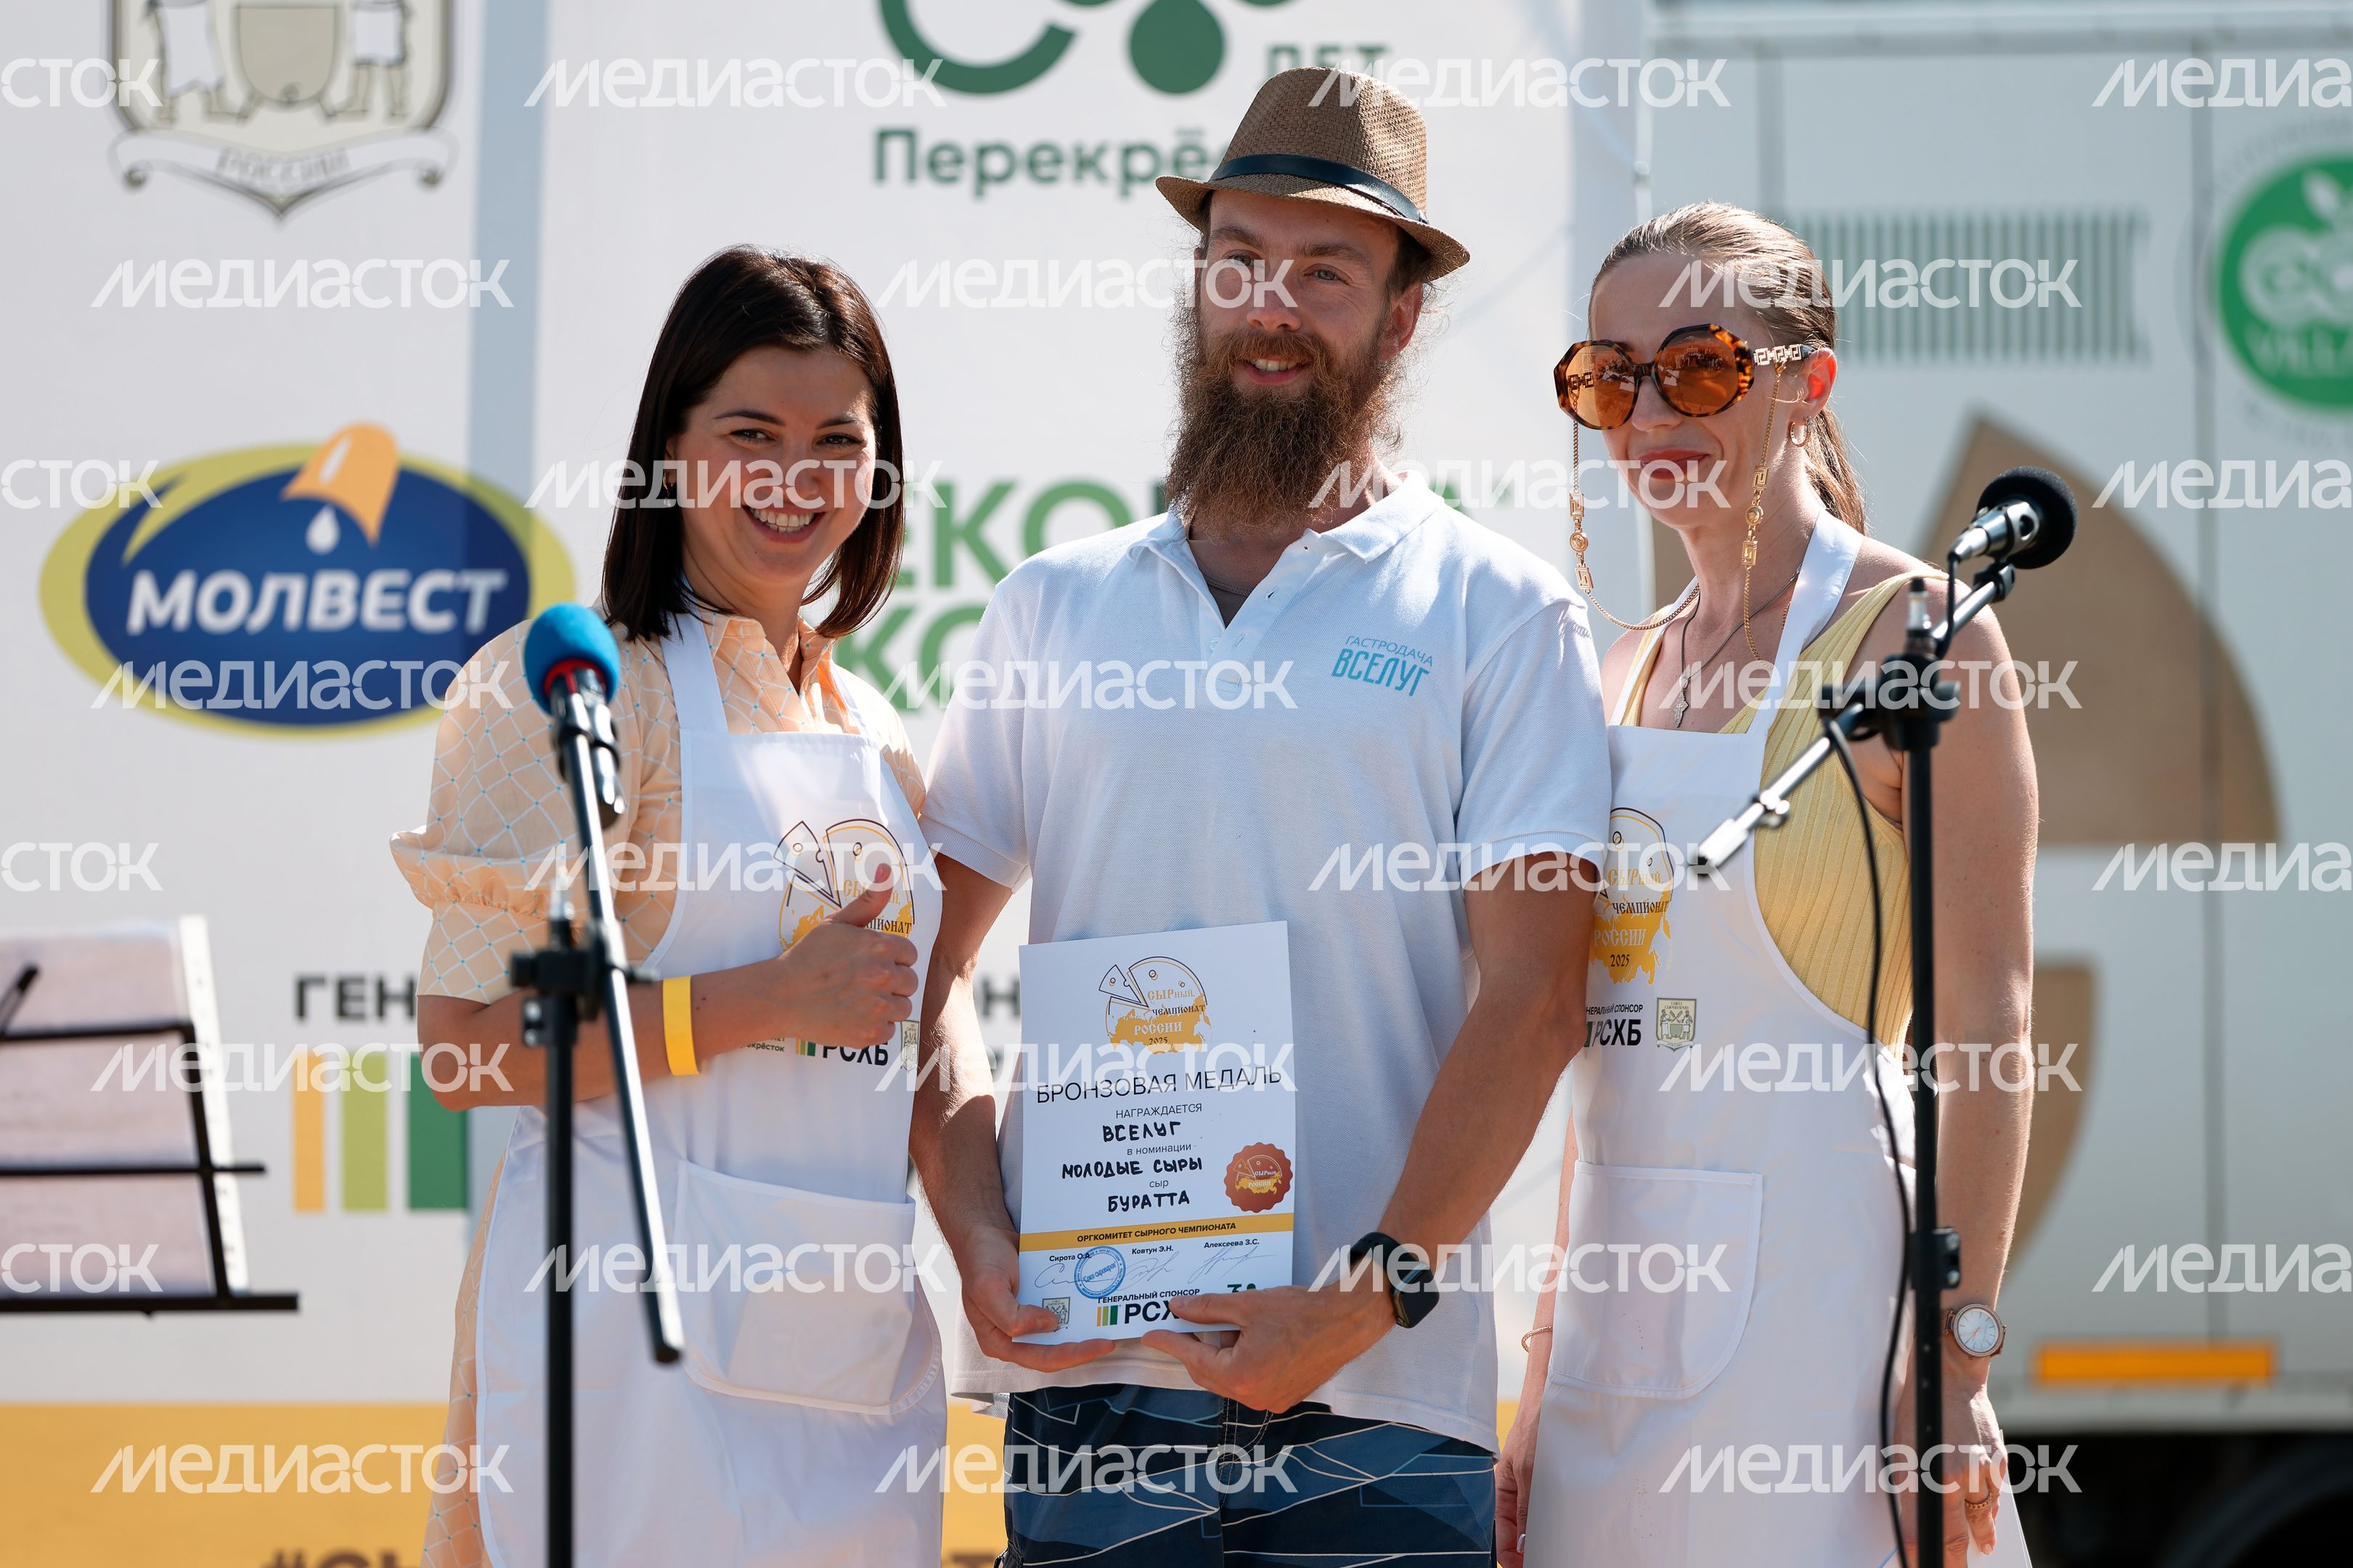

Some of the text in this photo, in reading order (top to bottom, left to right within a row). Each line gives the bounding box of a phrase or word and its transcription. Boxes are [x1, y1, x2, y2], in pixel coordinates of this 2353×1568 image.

[873, 128, 1221, 198] Перекрё
[127, 568, 507, 636] МОЛВЕСТ
[1345, 636, 1434, 667] ГАСТРОДАЧА
[1332, 648, 1430, 697] ВСЕЛУГ
[865, 918, 912, 934] ПИОНАТ
[1593, 928, 1647, 947] РОССИИ
[1610, 954, 1630, 968] 2025
[295, 975, 416, 1024] ГЕН
[1614, 1004, 1643, 1013] СПОНСОР
[1134, 1021, 1183, 1035] РОССИИ
[1591, 1018, 1642, 1047] РСХБ
[1149, 1037, 1168, 1045] 2025
[1037, 1065, 1281, 1103] БРОНЗОВАЯ МЕДАЛЬ
[1116, 1103, 1202, 1119] НАГРАЖДАЕТСЯ
[1102, 1121, 1181, 1143] ВСЕЛУГ
[1135, 1143, 1192, 1156] номинации
[1061, 1157, 1202, 1179] МОЛОДЫЕ СЫРЫ
[1149, 1179, 1169, 1190] сыр
[1107, 1190, 1190, 1212] БУРАТТА
[1077, 1222, 1236, 1243] ОРГКОМИТЕТ СЫРНОГО ЧЕМПИОНАТА
[1131, 1244, 1174, 1255] Ковтун Э.Н.
[1204, 1240, 1244, 1249] Алексеева
[1049, 1253, 1076, 1263] Сирота
[1098, 1289, 1200, 1304] ГЕНЕРАЛЬНЫЙ СПОНСОР
[1124, 1300, 1180, 1324] РСХ
